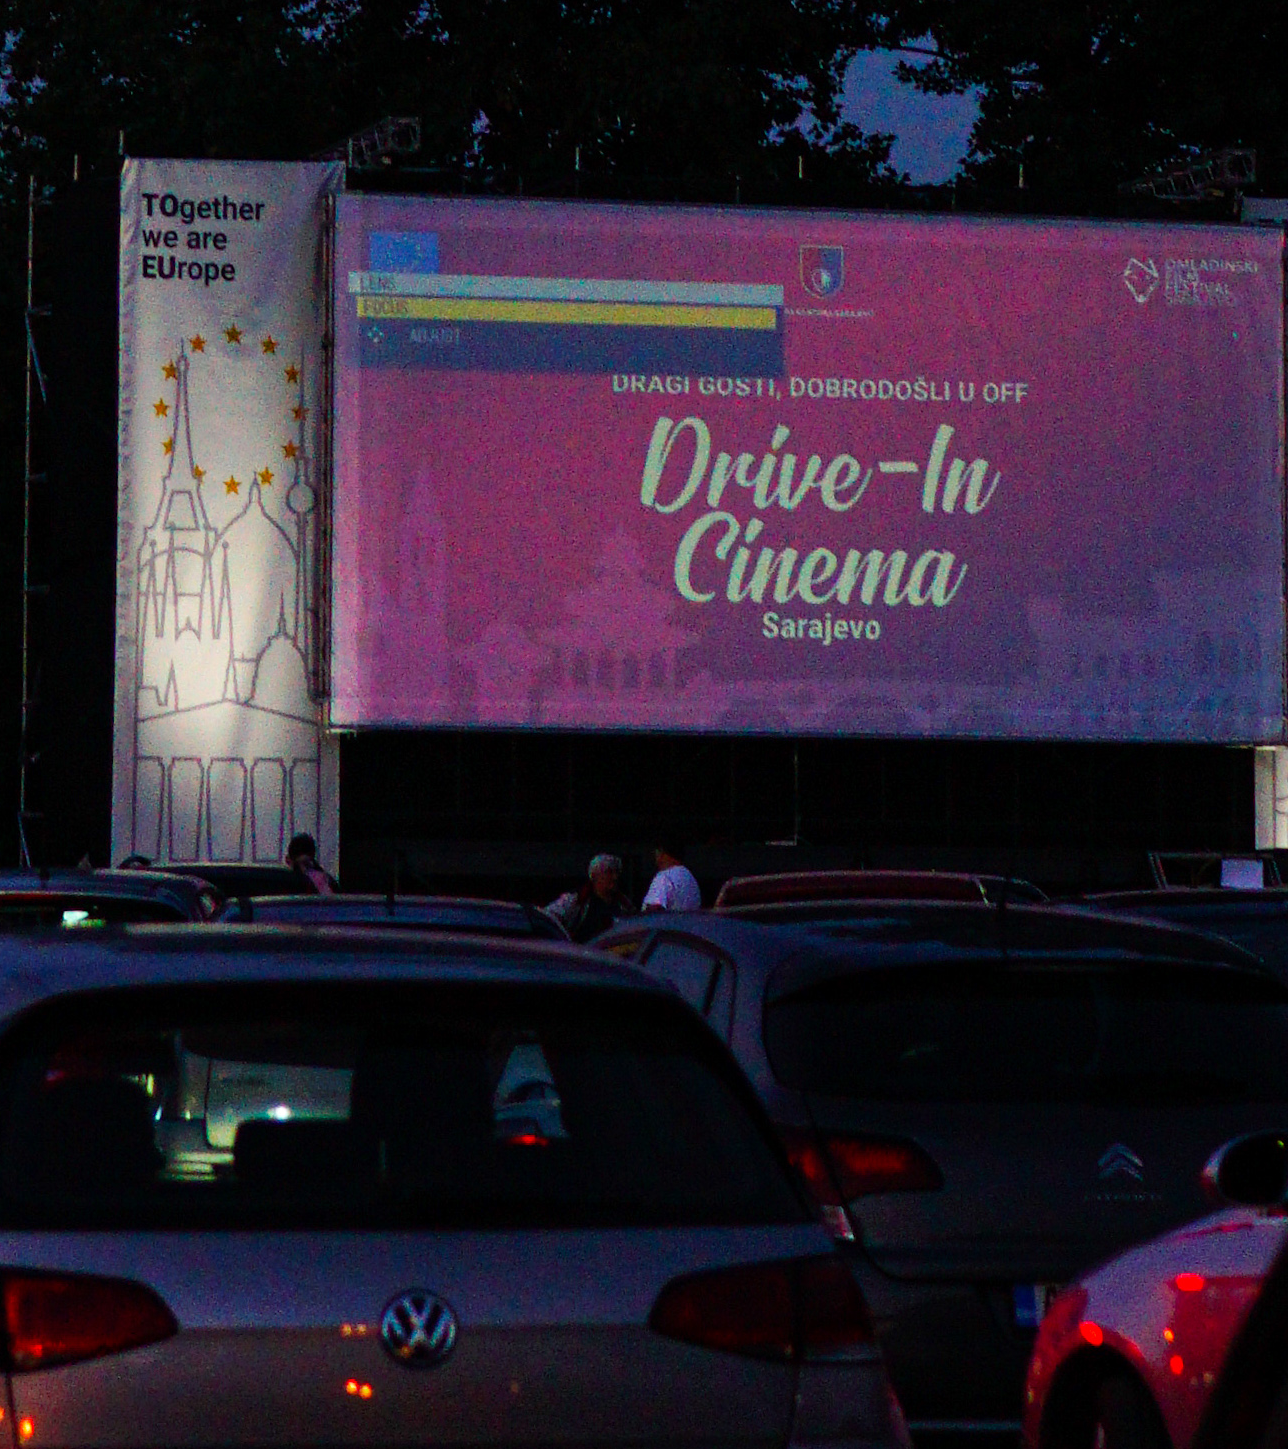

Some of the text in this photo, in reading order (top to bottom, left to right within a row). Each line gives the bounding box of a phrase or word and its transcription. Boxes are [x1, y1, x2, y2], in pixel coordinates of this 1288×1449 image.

[141, 193, 265, 224] TOgether
[141, 229, 227, 250] we are
[141, 255, 235, 287] EUrope
[613, 374, 1029, 403] DRAGI GOSTI, DOBRODOŠLI U OFF
[641, 416, 1001, 514] Drive-In
[674, 510, 968, 607] Cinema
[762, 611, 881, 646] Sarajevo
